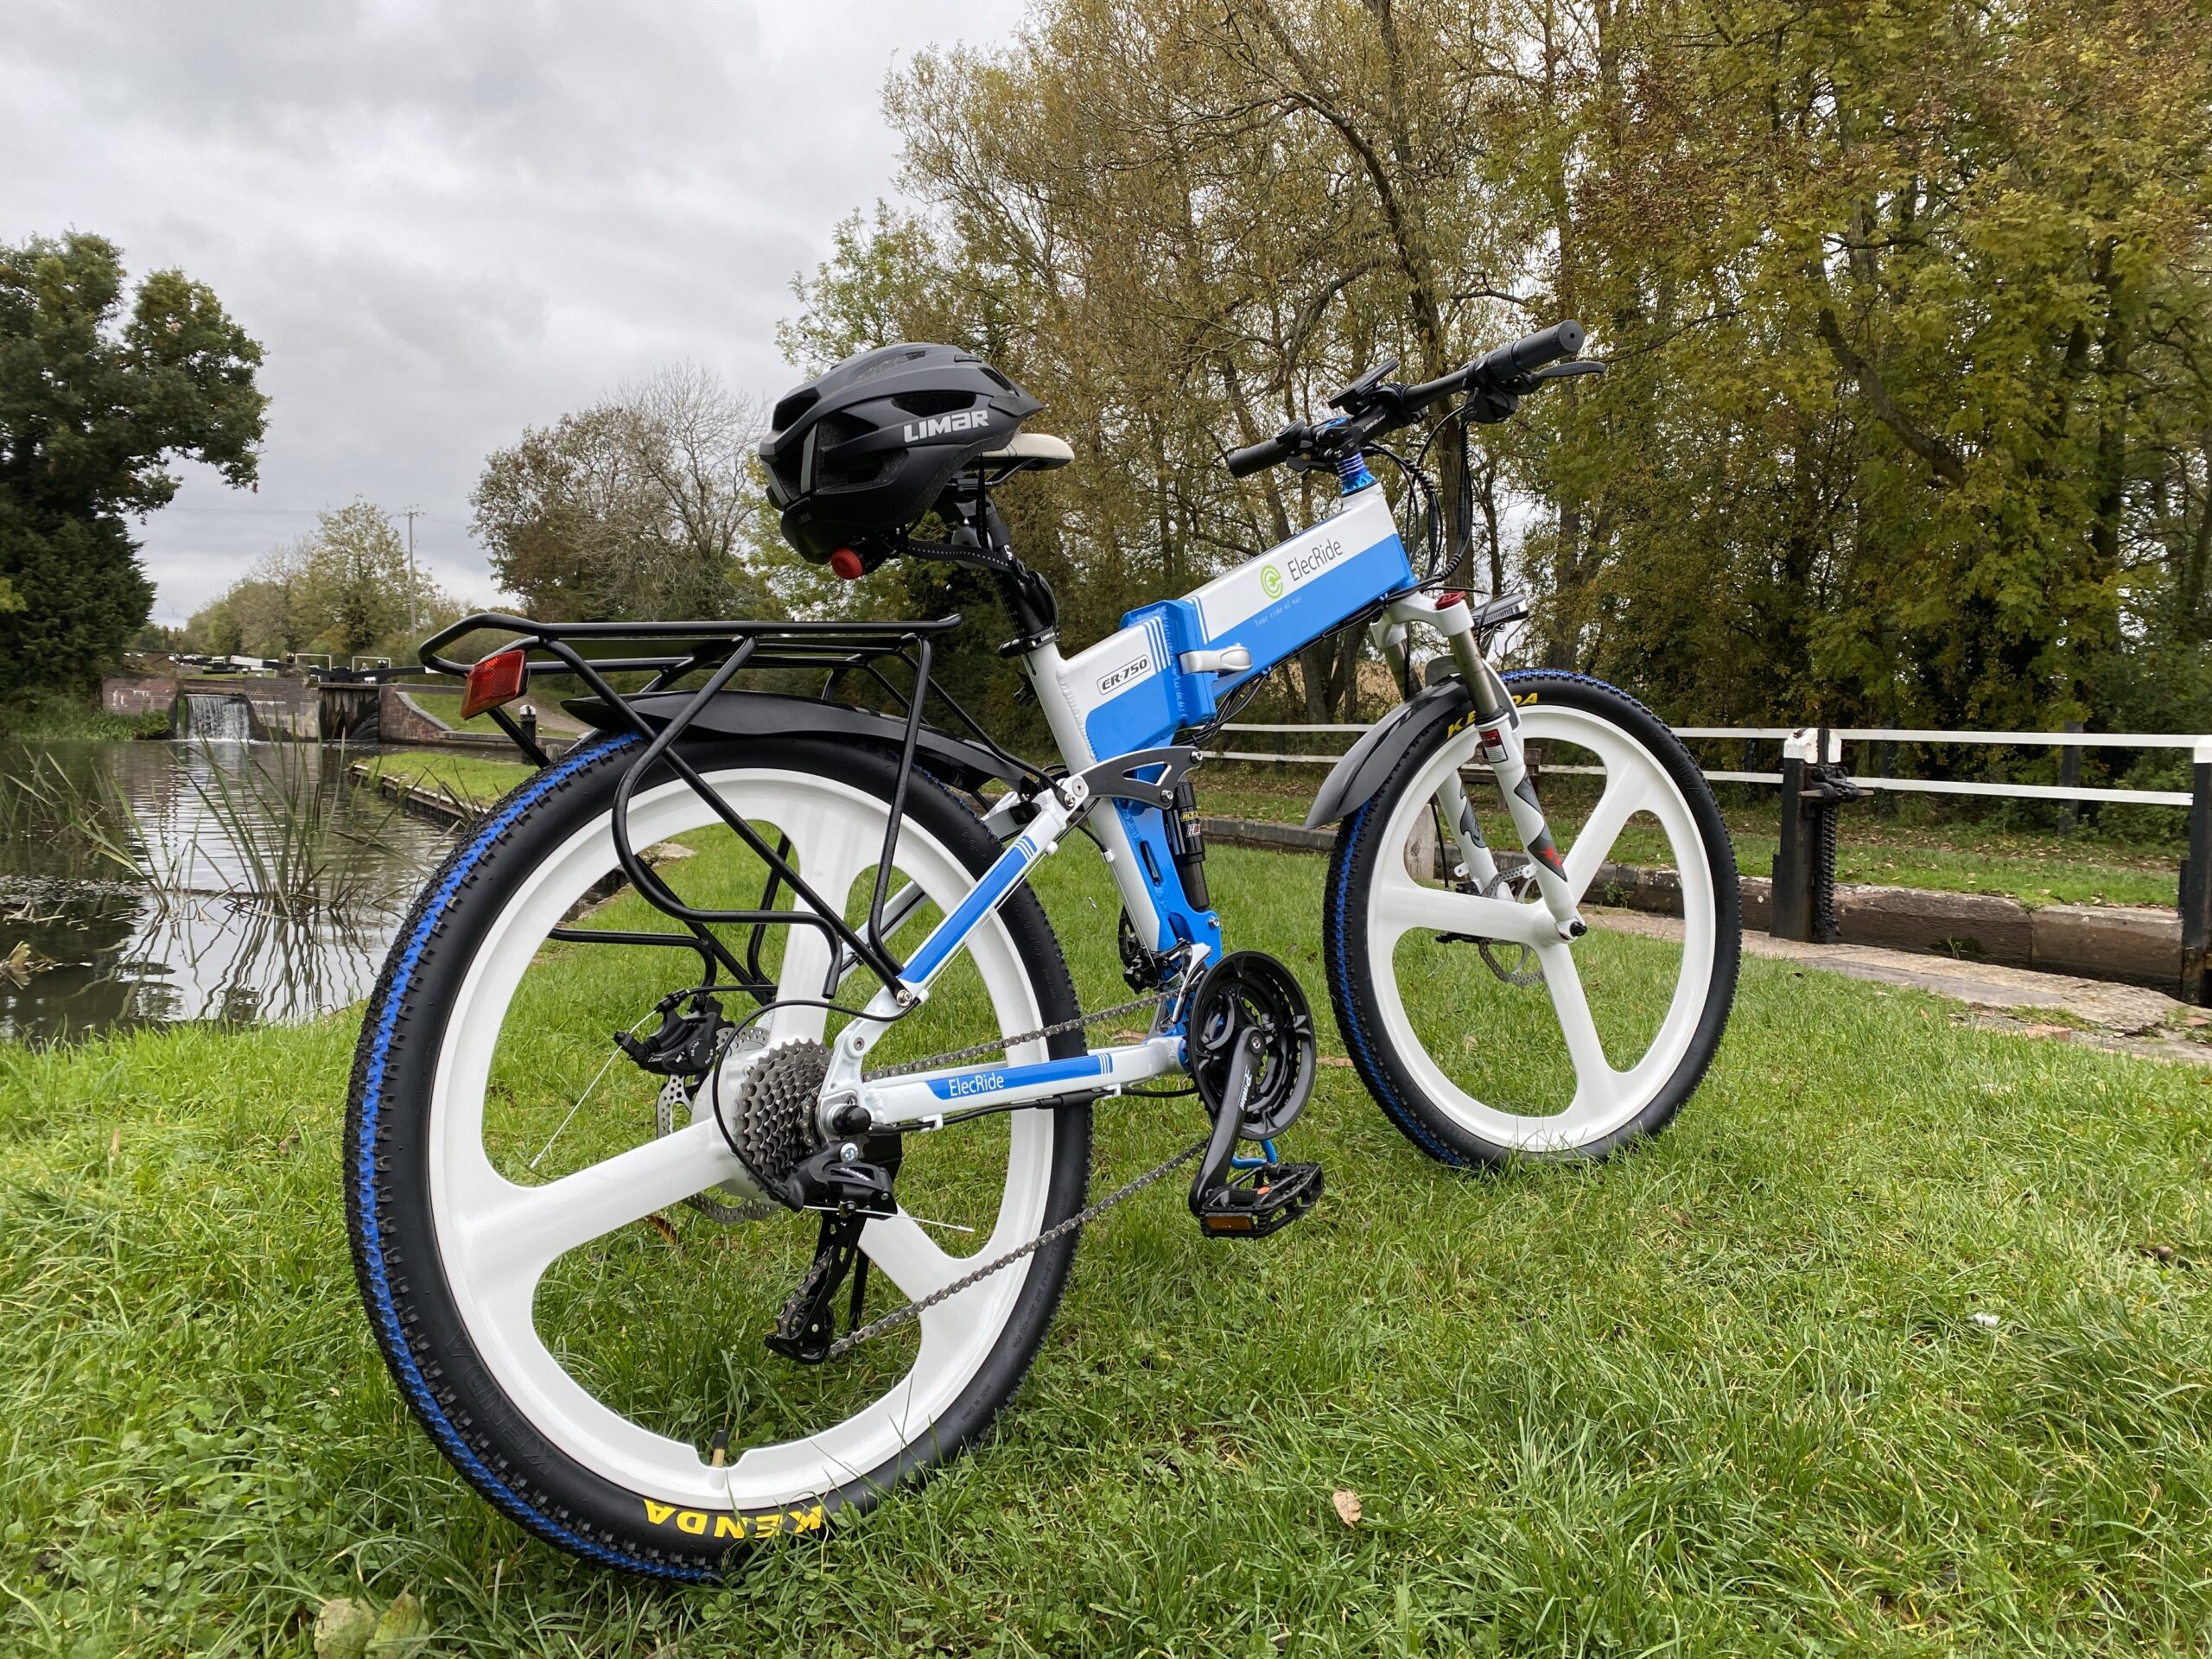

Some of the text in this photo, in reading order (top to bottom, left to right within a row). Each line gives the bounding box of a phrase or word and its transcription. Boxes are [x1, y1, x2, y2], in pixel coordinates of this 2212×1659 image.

[904, 410, 989, 443] LIMAR
[1287, 538, 1343, 582] ElecRide
[1101, 658, 1148, 691] ER-750
[949, 1072, 1005, 1097] ElecRide
[445, 1326, 559, 1476] KENDA
[643, 1498, 824, 1541] KENDA
